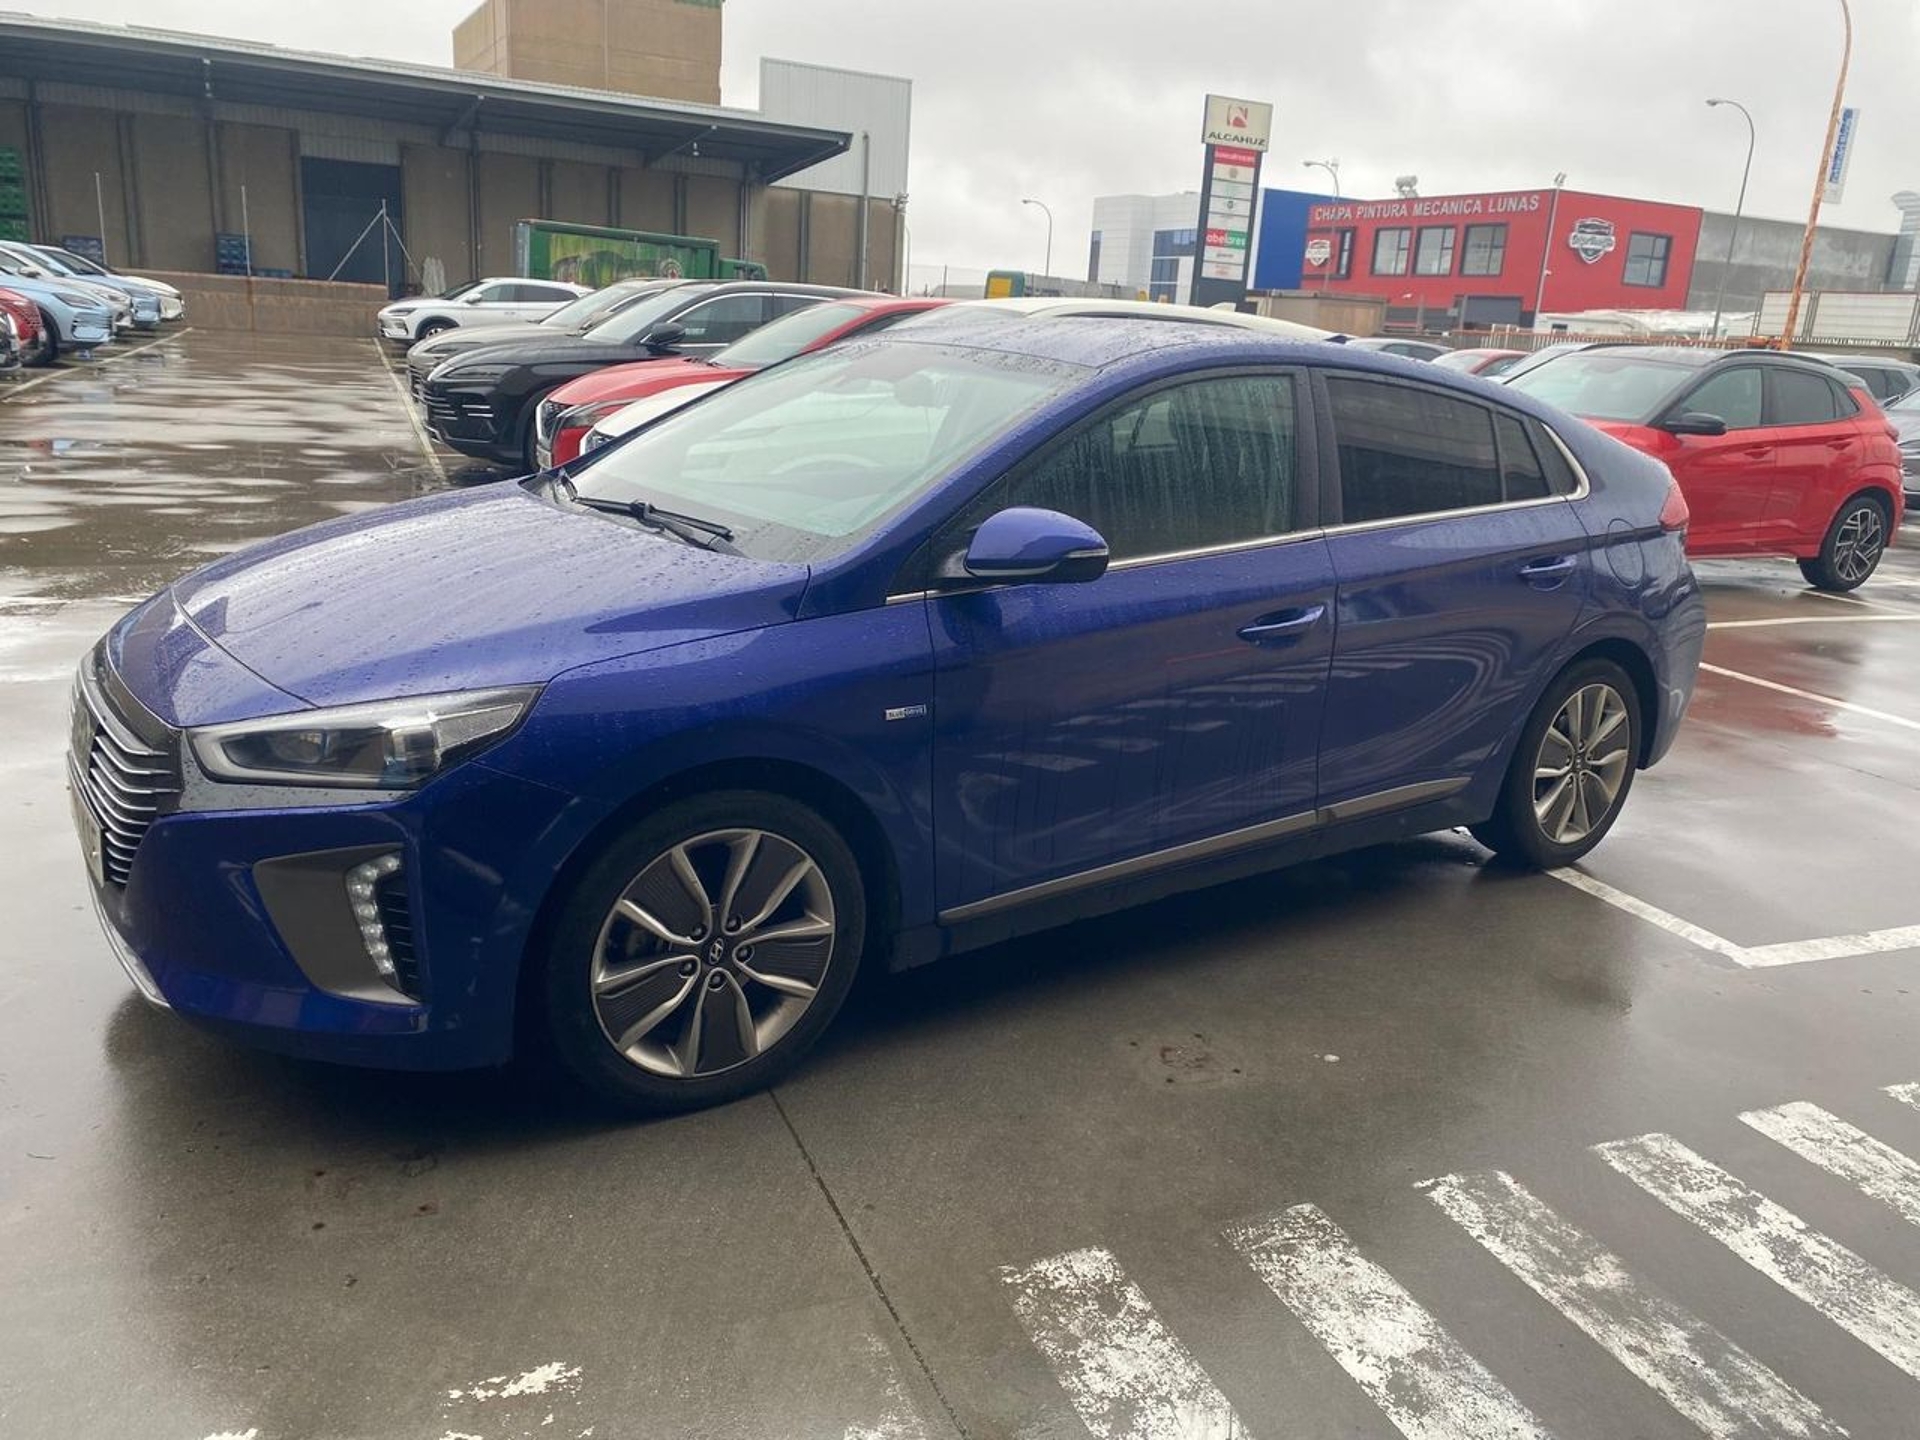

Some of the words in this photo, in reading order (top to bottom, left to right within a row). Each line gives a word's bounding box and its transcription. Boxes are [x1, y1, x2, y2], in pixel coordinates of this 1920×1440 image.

[1208, 131, 1266, 146] ALCAHUZ
[1315, 206, 1352, 221] CHAPA
[1356, 203, 1408, 219] PINTURA
[1412, 199, 1482, 217] MECANICA
[1488, 195, 1540, 213] LUNAS
